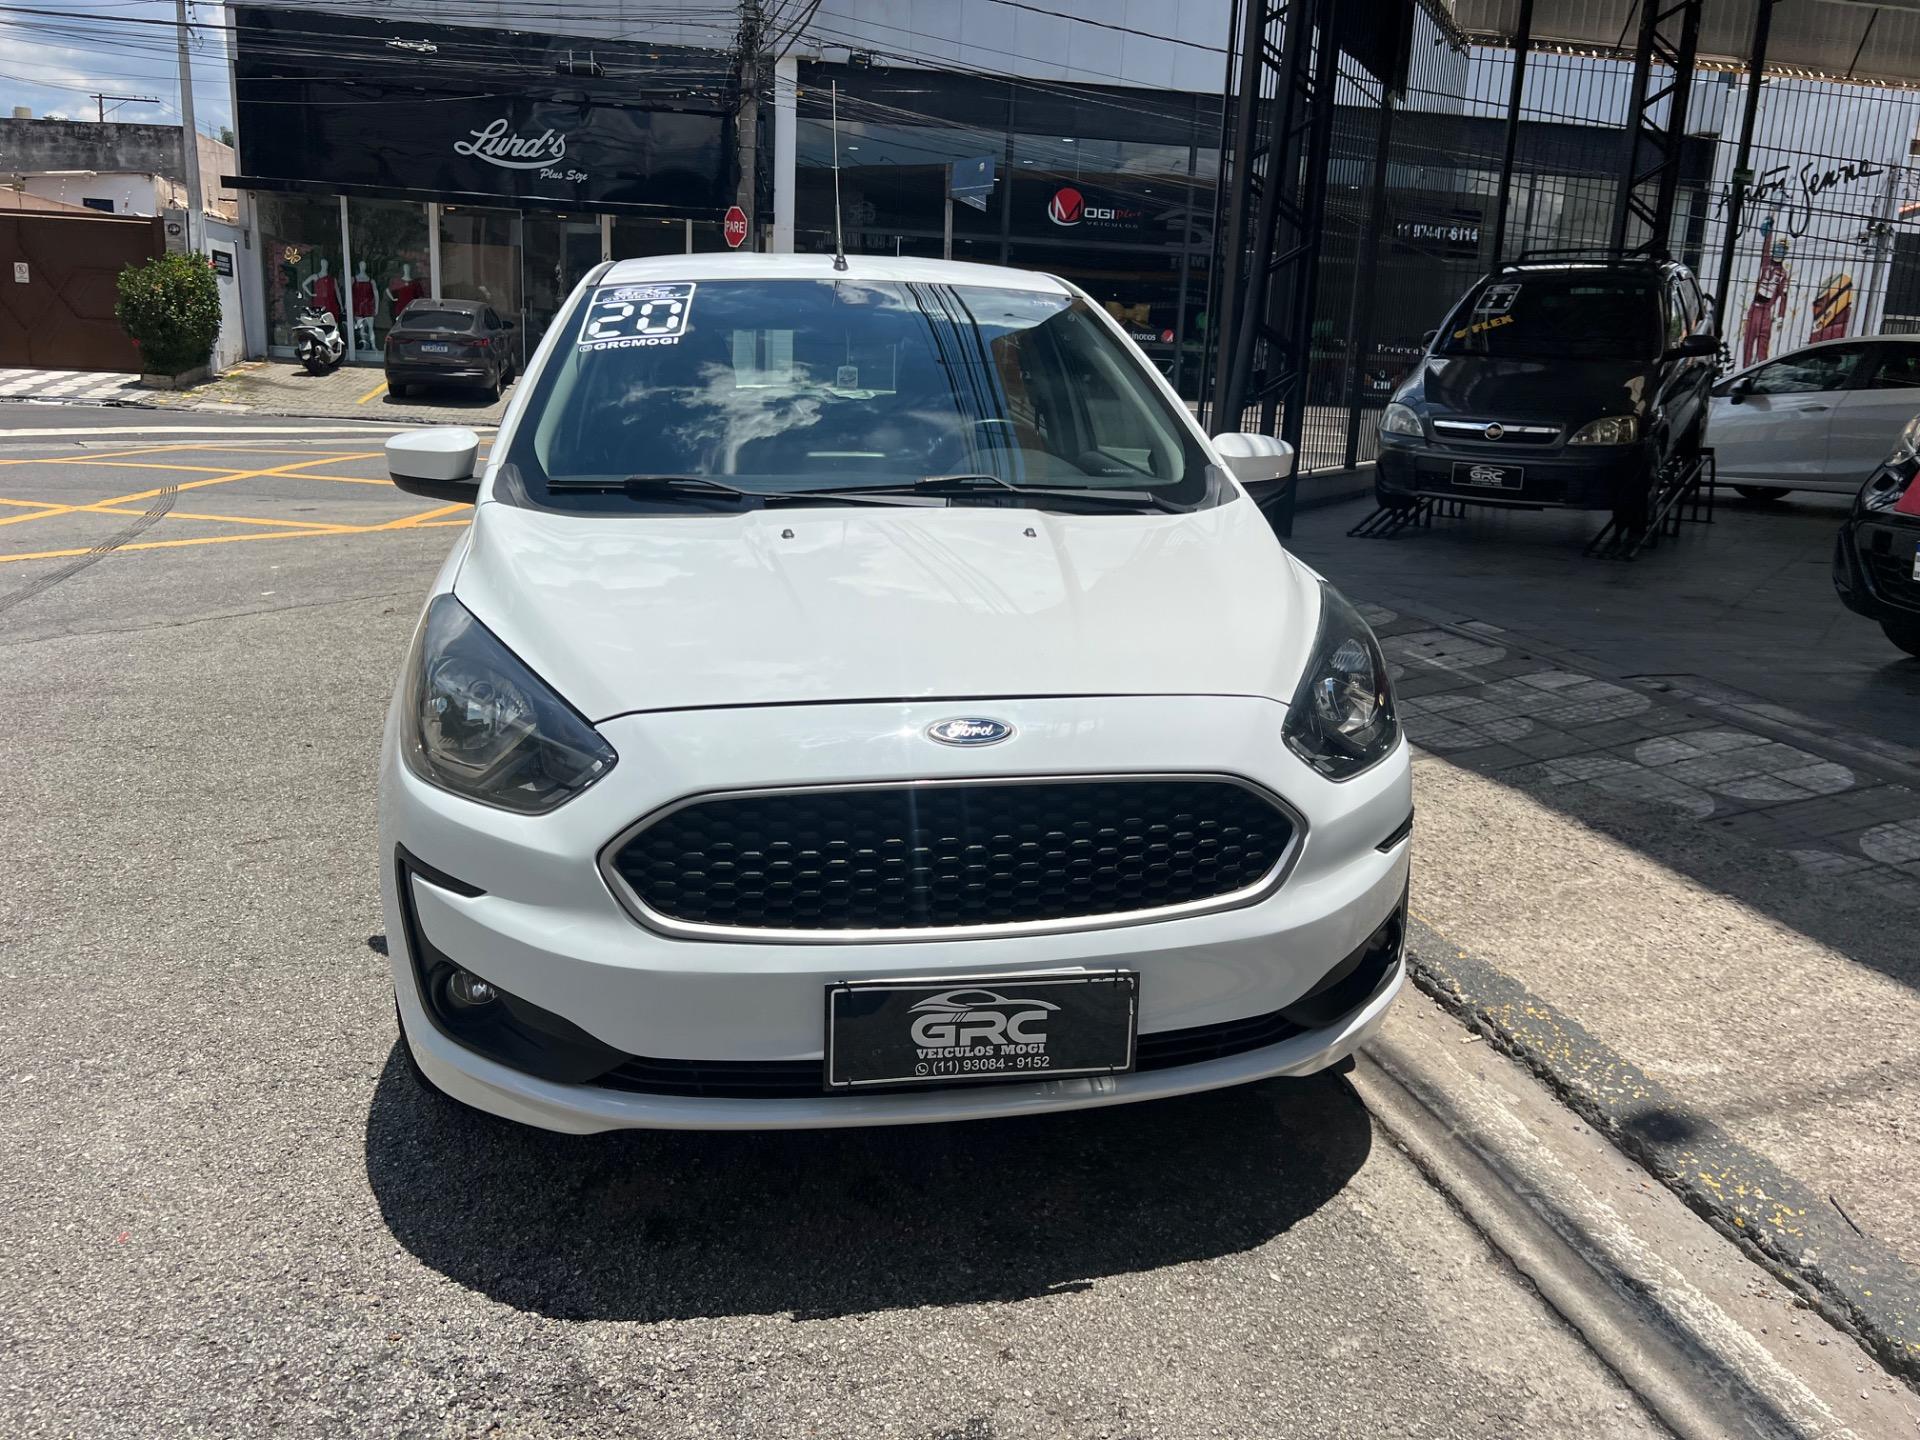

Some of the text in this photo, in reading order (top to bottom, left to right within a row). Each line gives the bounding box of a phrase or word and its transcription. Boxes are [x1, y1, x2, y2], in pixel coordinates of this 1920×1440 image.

[453, 118, 566, 168] Lurd's
[540, 168, 589, 183] Plus Size
[726, 220, 745, 233] PARE
[588, 300, 682, 338] 20
[1472, 315, 1514, 333] FLEX
[1470, 470, 1503, 481] GRC
[947, 720, 994, 738] Ford
[911, 1010, 1048, 1047] GRC
[916, 1043, 1045, 1059] VEICULOS MOGI
[932, 1061, 959, 1075] (11)
[963, 1058, 1005, 1071] 93084
[1017, 1056, 1050, 1069] 9152
